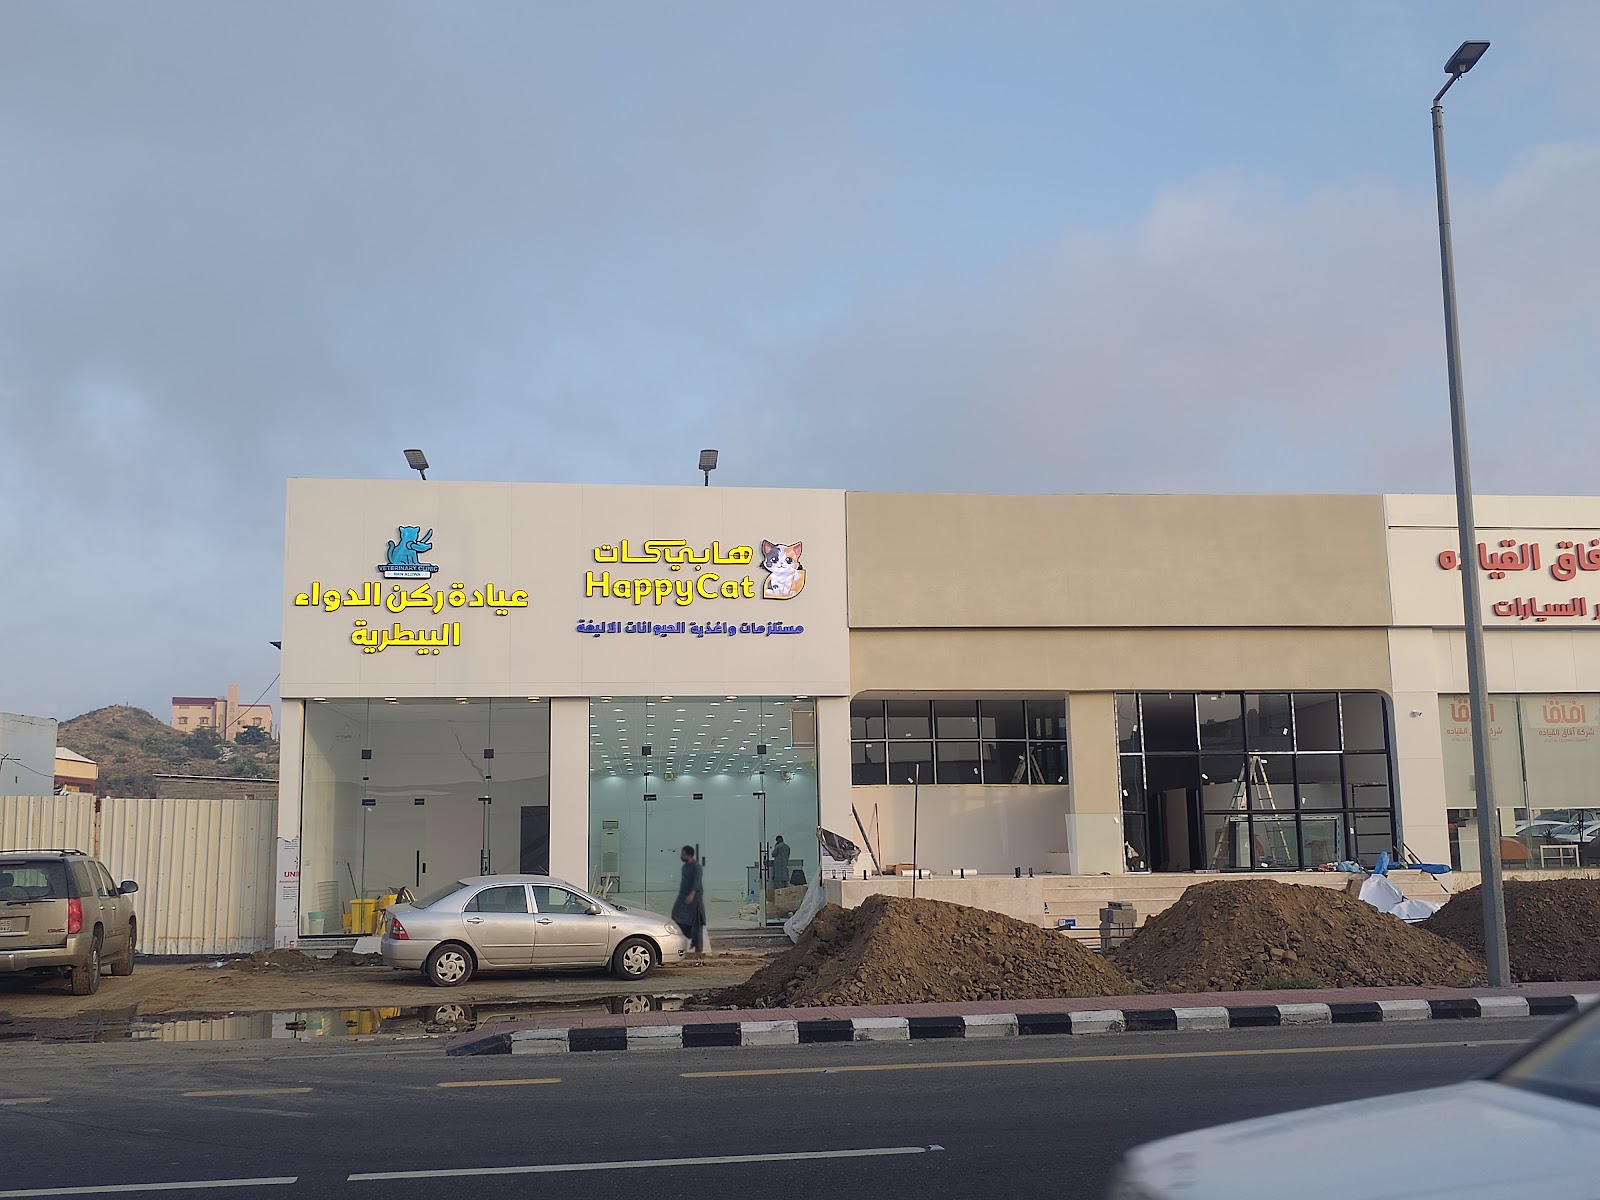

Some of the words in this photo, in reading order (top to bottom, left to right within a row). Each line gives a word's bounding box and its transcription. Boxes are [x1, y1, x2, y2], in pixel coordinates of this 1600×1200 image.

[1438, 539, 1541, 579] القياه
[1551, 538, 1600, 581] فاق
[294, 581, 382, 612] الدواء
[386, 583, 444, 614] ركن
[448, 582, 529, 616] عيادة
[1493, 597, 1587, 621] السيارات
[351, 619, 461, 655] البيطرية
[576, 618, 622, 638] الاليفة
[624, 621, 686, 638] الحيوانات
[689, 621, 737, 638] واغذية
[739, 621, 804, 636] مستلزمات
[1576, 728, 1595, 738] شركة
